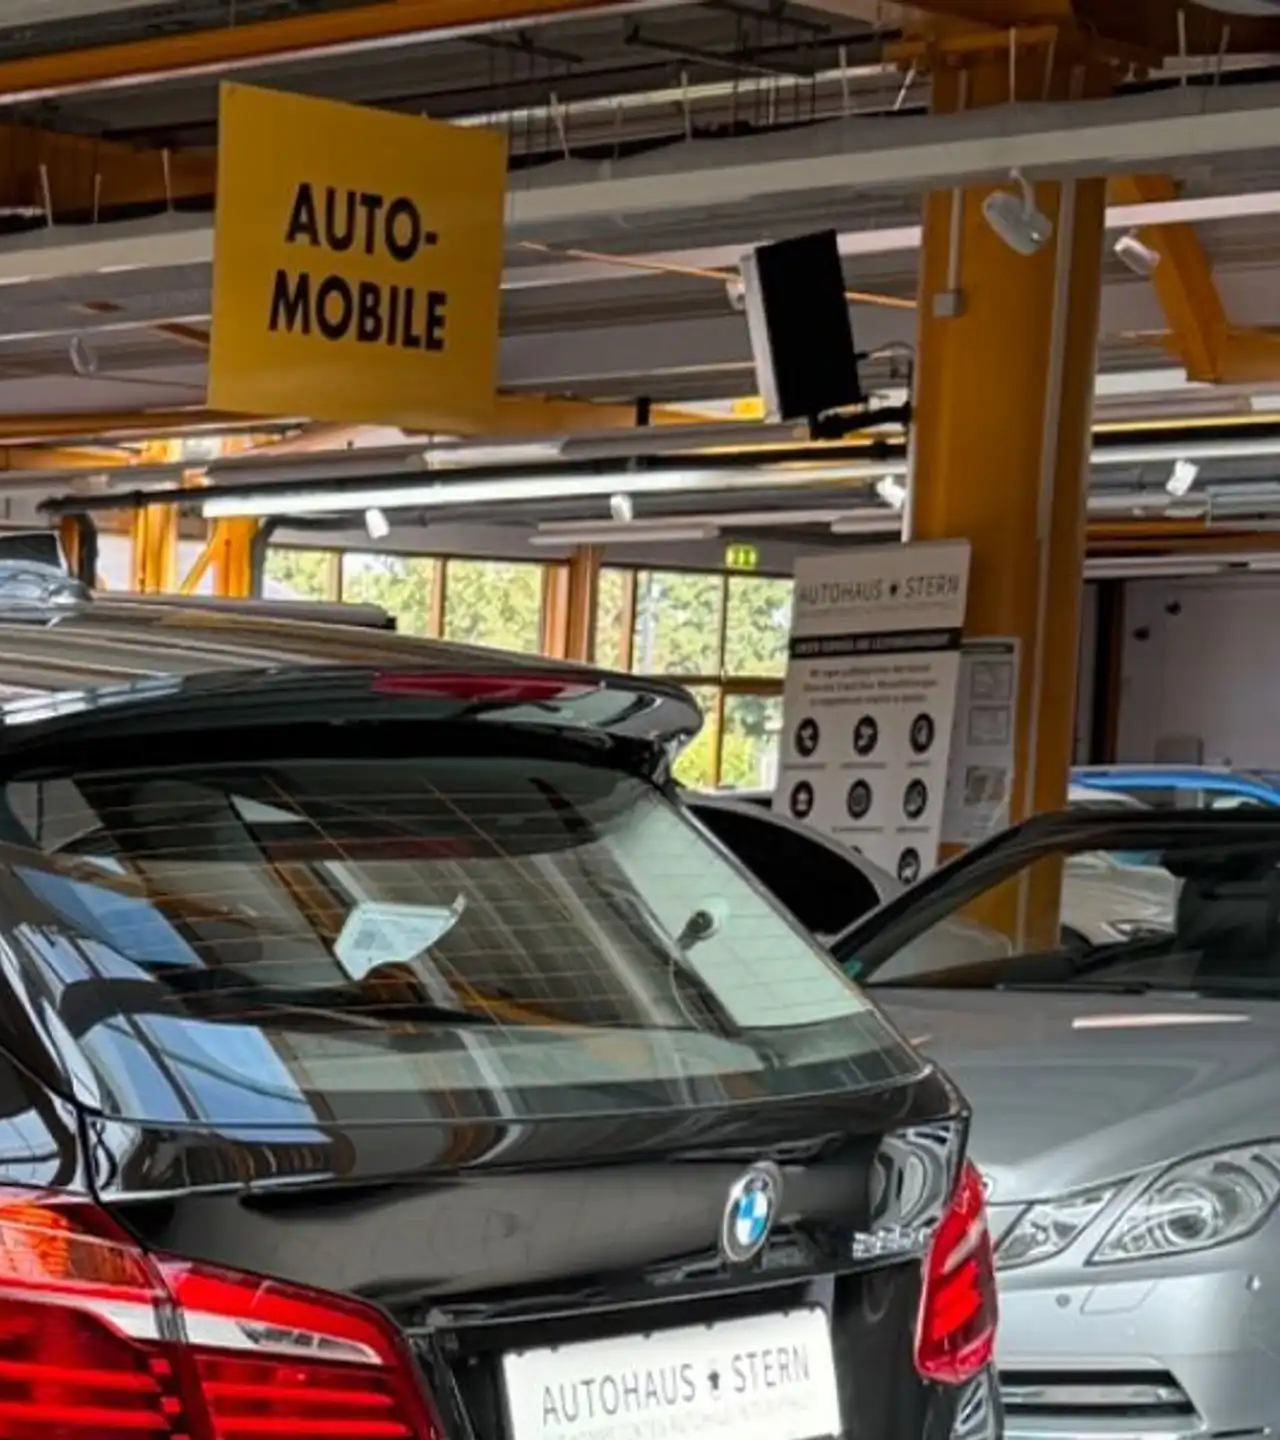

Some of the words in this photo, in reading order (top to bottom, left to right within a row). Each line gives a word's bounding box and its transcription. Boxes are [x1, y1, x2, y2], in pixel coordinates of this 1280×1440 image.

[284, 182, 438, 262] AUTO-
[267, 269, 448, 351] MOBILE
[797, 579, 883, 605] AUTOHAUS
[904, 574, 960, 599] STERN
[542, 1363, 697, 1427] AUTOHAUS
[730, 1344, 811, 1393] STERN
